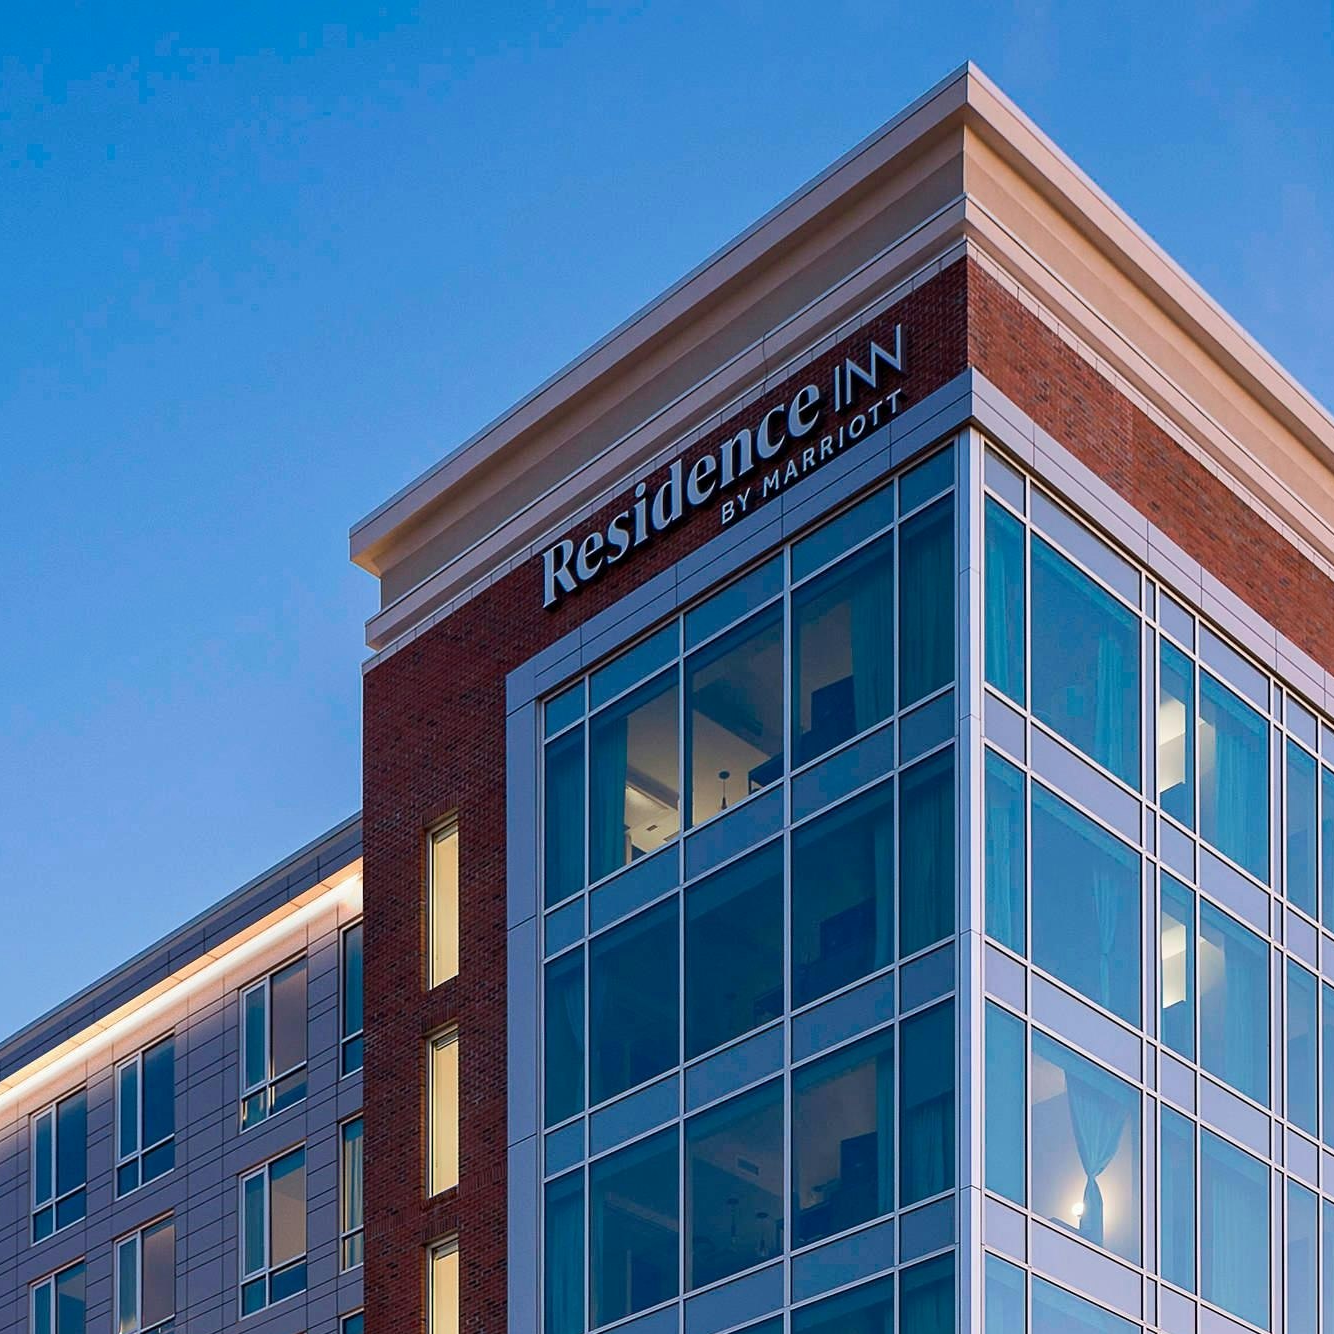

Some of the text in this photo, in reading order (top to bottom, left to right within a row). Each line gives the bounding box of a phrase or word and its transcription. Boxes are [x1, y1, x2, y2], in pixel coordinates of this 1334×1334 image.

[542, 323, 905, 609] Residence INN
[721, 388, 903, 526] BY MARRIOTT
